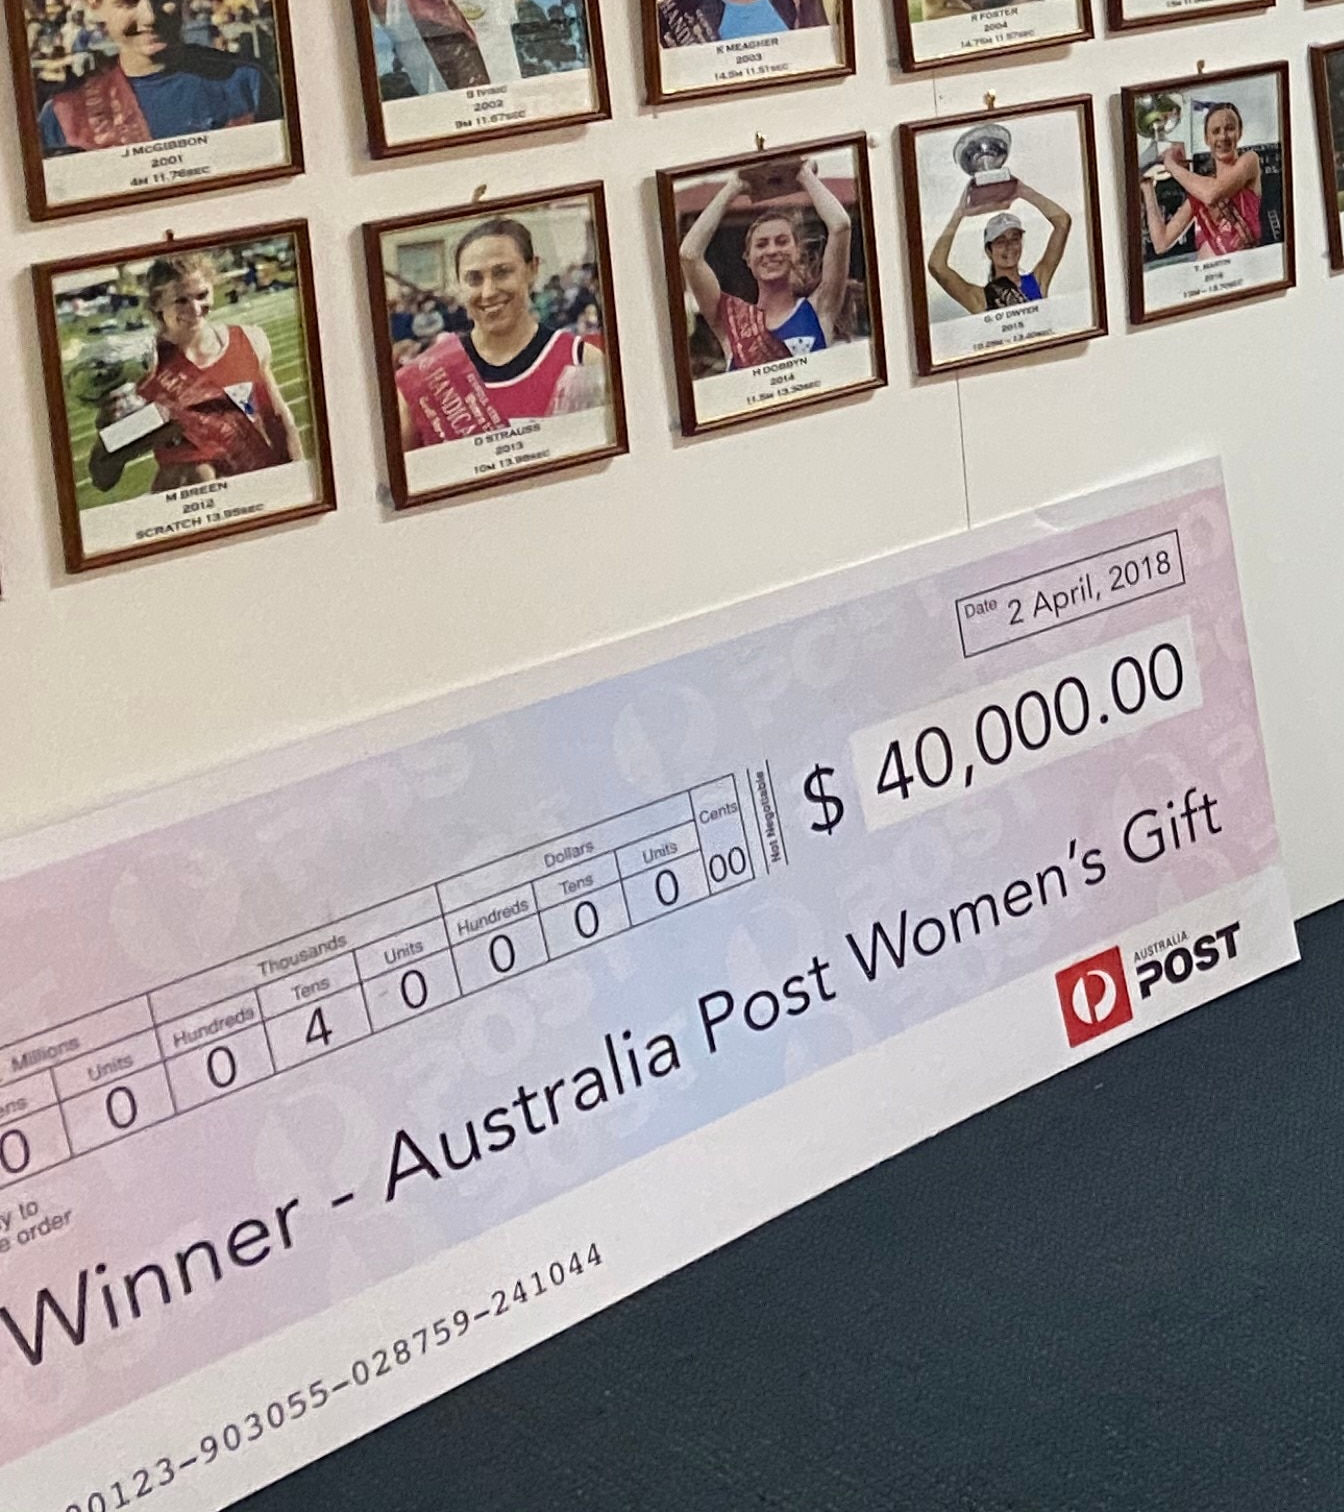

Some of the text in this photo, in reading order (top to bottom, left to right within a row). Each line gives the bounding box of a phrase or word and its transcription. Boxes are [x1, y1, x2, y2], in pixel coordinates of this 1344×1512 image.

[984, 21, 1008, 33] 2004
[726, 37, 779, 53] MEAGHER
[473, 99, 504, 112] 2002
[121, 147, 130, 158] J
[151, 155, 184, 169] 2001
[769, 373, 795, 387] 2014
[486, 422, 542, 444] STRAUSS
[165, 480, 229, 504] M BREEN
[182, 497, 216, 514] 2012
[135, 518, 203, 541] SCRATCH
[964, 549, 1172, 627] Date 2 April, 2018
[802, 641, 1184, 836] $ 40,000.00
[698, 800, 740, 825] Cents
[543, 839, 595, 869] Dollars
[257, 932, 348, 979] Thousands
[1132, 929, 1189, 963] AUSTRALIA
[87, 840, 679, 1081] Units Hundreds Tens Units Hundreds Tens Units
[1134, 920, 1243, 1000] POST
[0, 846, 748, 1174] 0 0 0 4 0 0 0 0 00
[10, 1034, 81, 1073] Millions
[0, 1196, 301, 1366] Winner
[384, 1028, 682, 1203] Australia
[698, 956, 837, 1054] Post
[846, 838, 1106, 981] Women's
[1123, 787, 1224, 865] Gift
[19, 1200, 39, 1220] to
[16, 1209, 73, 1246] order
